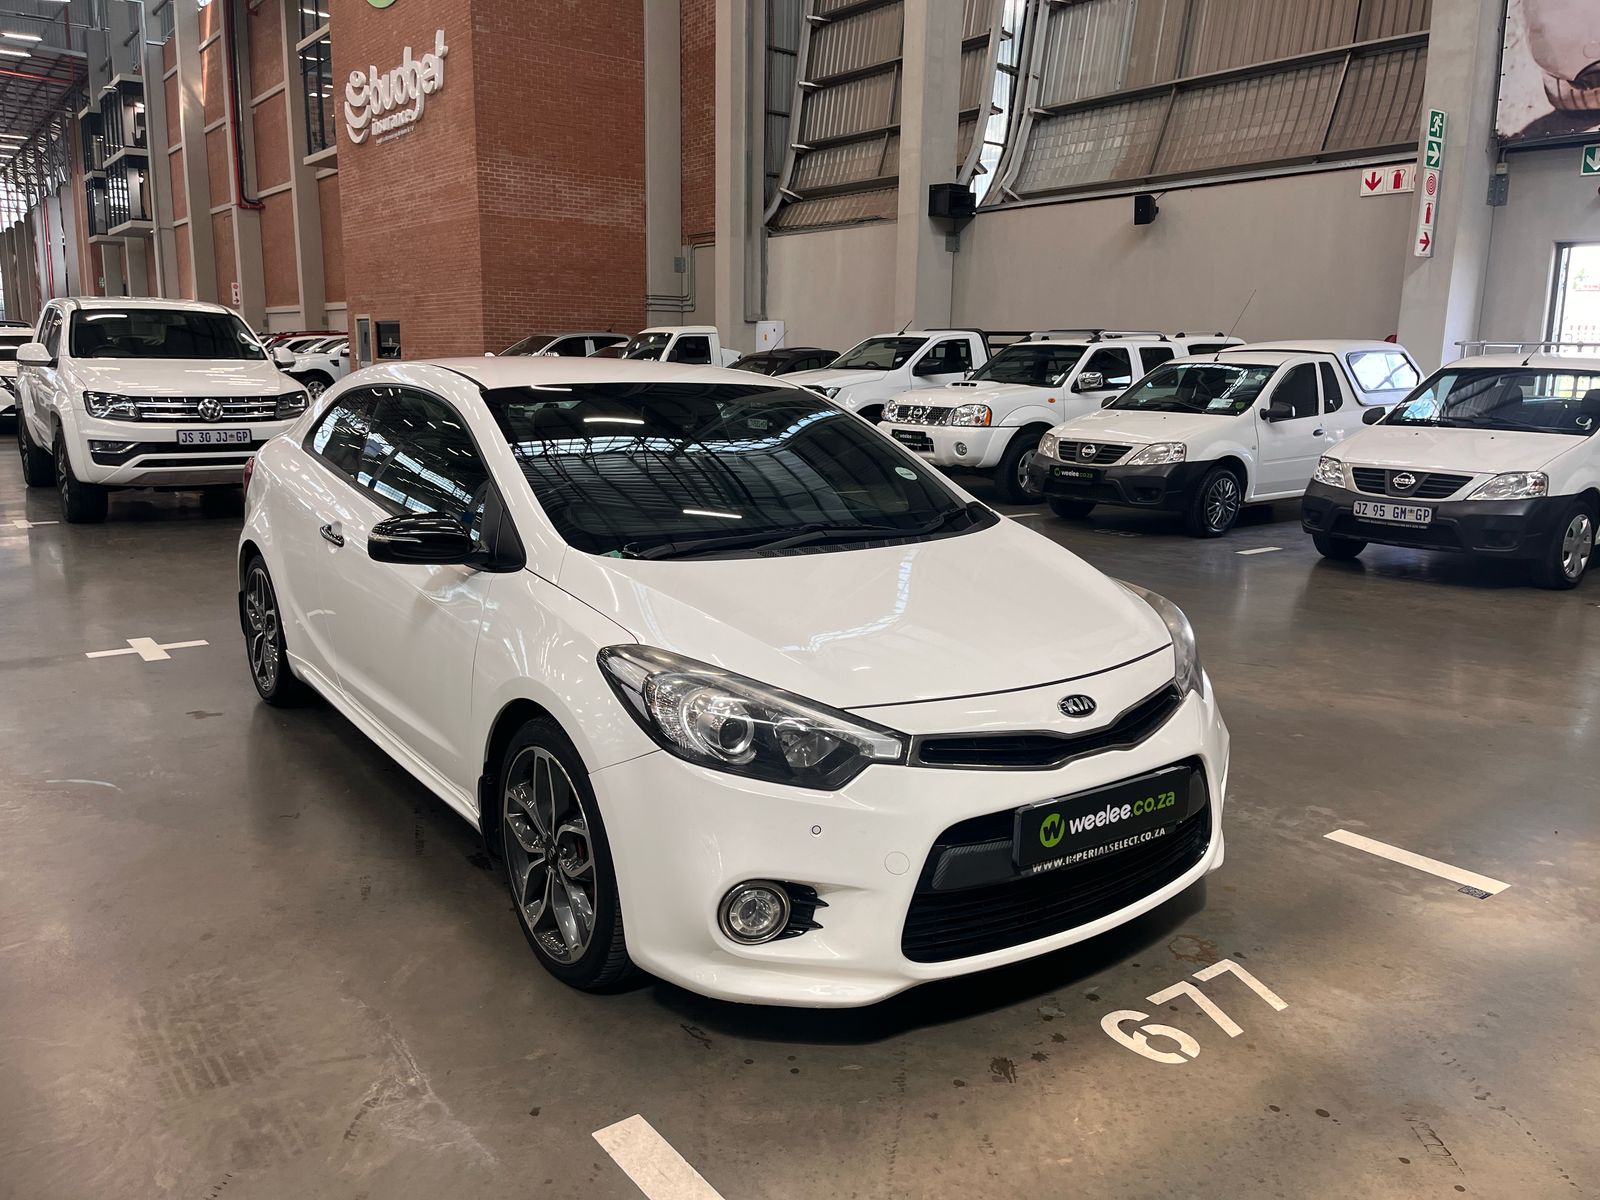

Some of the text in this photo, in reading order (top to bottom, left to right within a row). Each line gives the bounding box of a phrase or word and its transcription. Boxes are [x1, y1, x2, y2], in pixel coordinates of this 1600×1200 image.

[369, 29, 449, 121] budget
[181, 431, 248, 443] JS 30 JJ GP
[1355, 502, 1430, 522] JZ 95 GM GP
[1064, 696, 1095, 714] KIA
[1069, 791, 1176, 835] weelee.co.za
[1032, 827, 1166, 873] WWW.IMPERIALSELECT.CO.ZA
[1100, 958, 1290, 1064] 677
